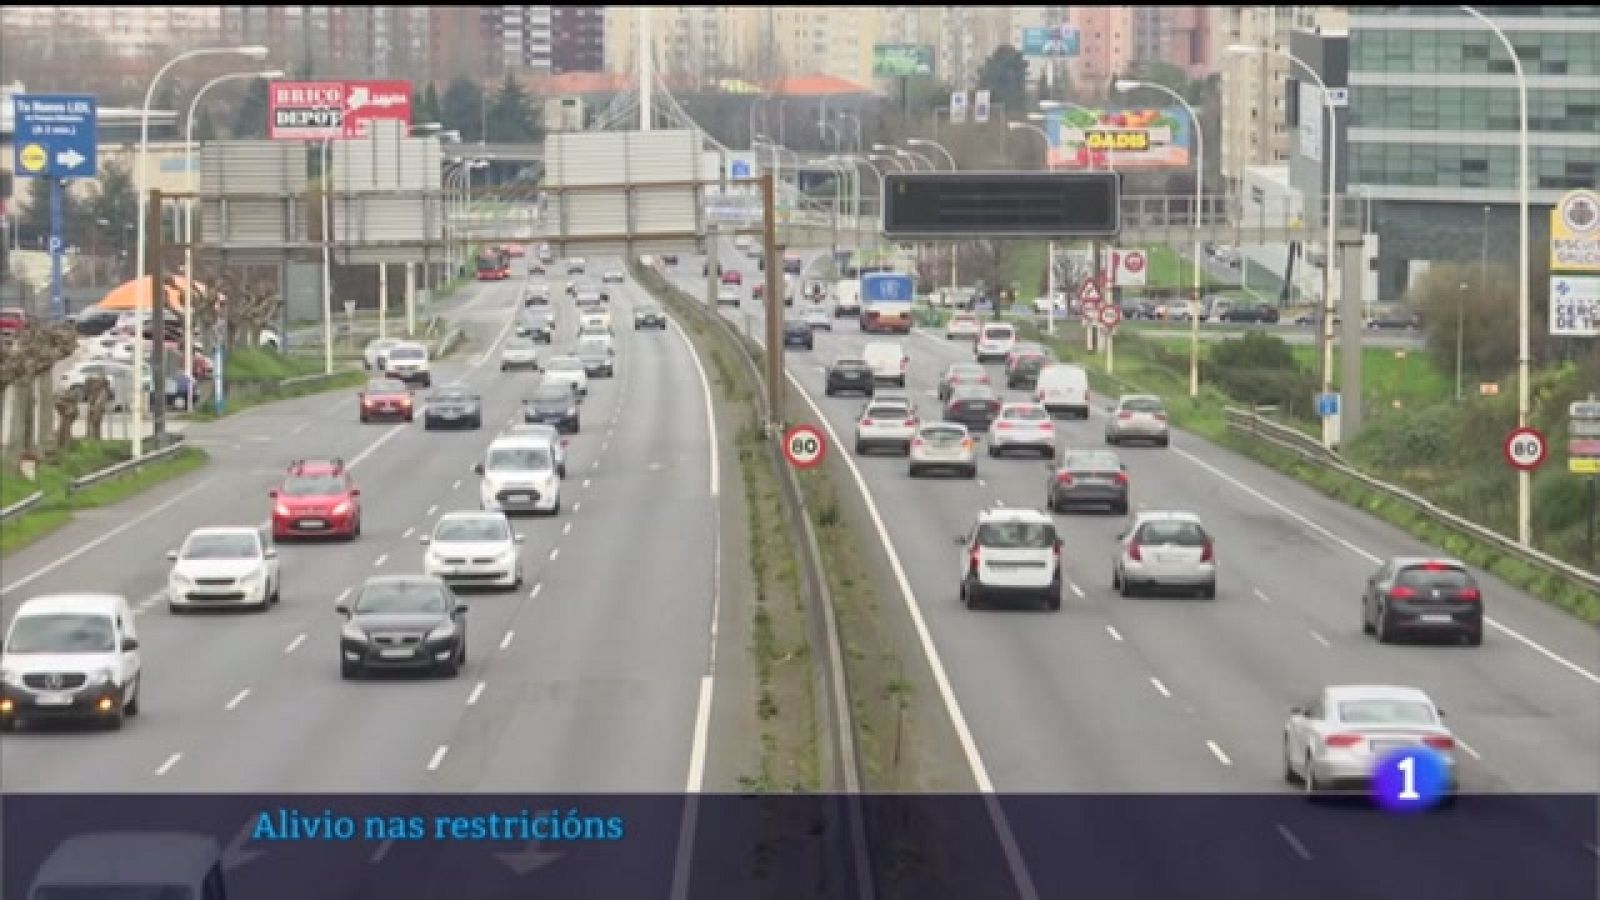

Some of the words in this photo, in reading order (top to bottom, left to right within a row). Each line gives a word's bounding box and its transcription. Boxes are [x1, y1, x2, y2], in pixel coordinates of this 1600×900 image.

[276, 88, 341, 103] BRICO
[1088, 132, 1146, 149] GADIS
[1557, 317, 1574, 329] DE
[792, 437, 818, 455] 80
[1514, 441, 1538, 456] 80
